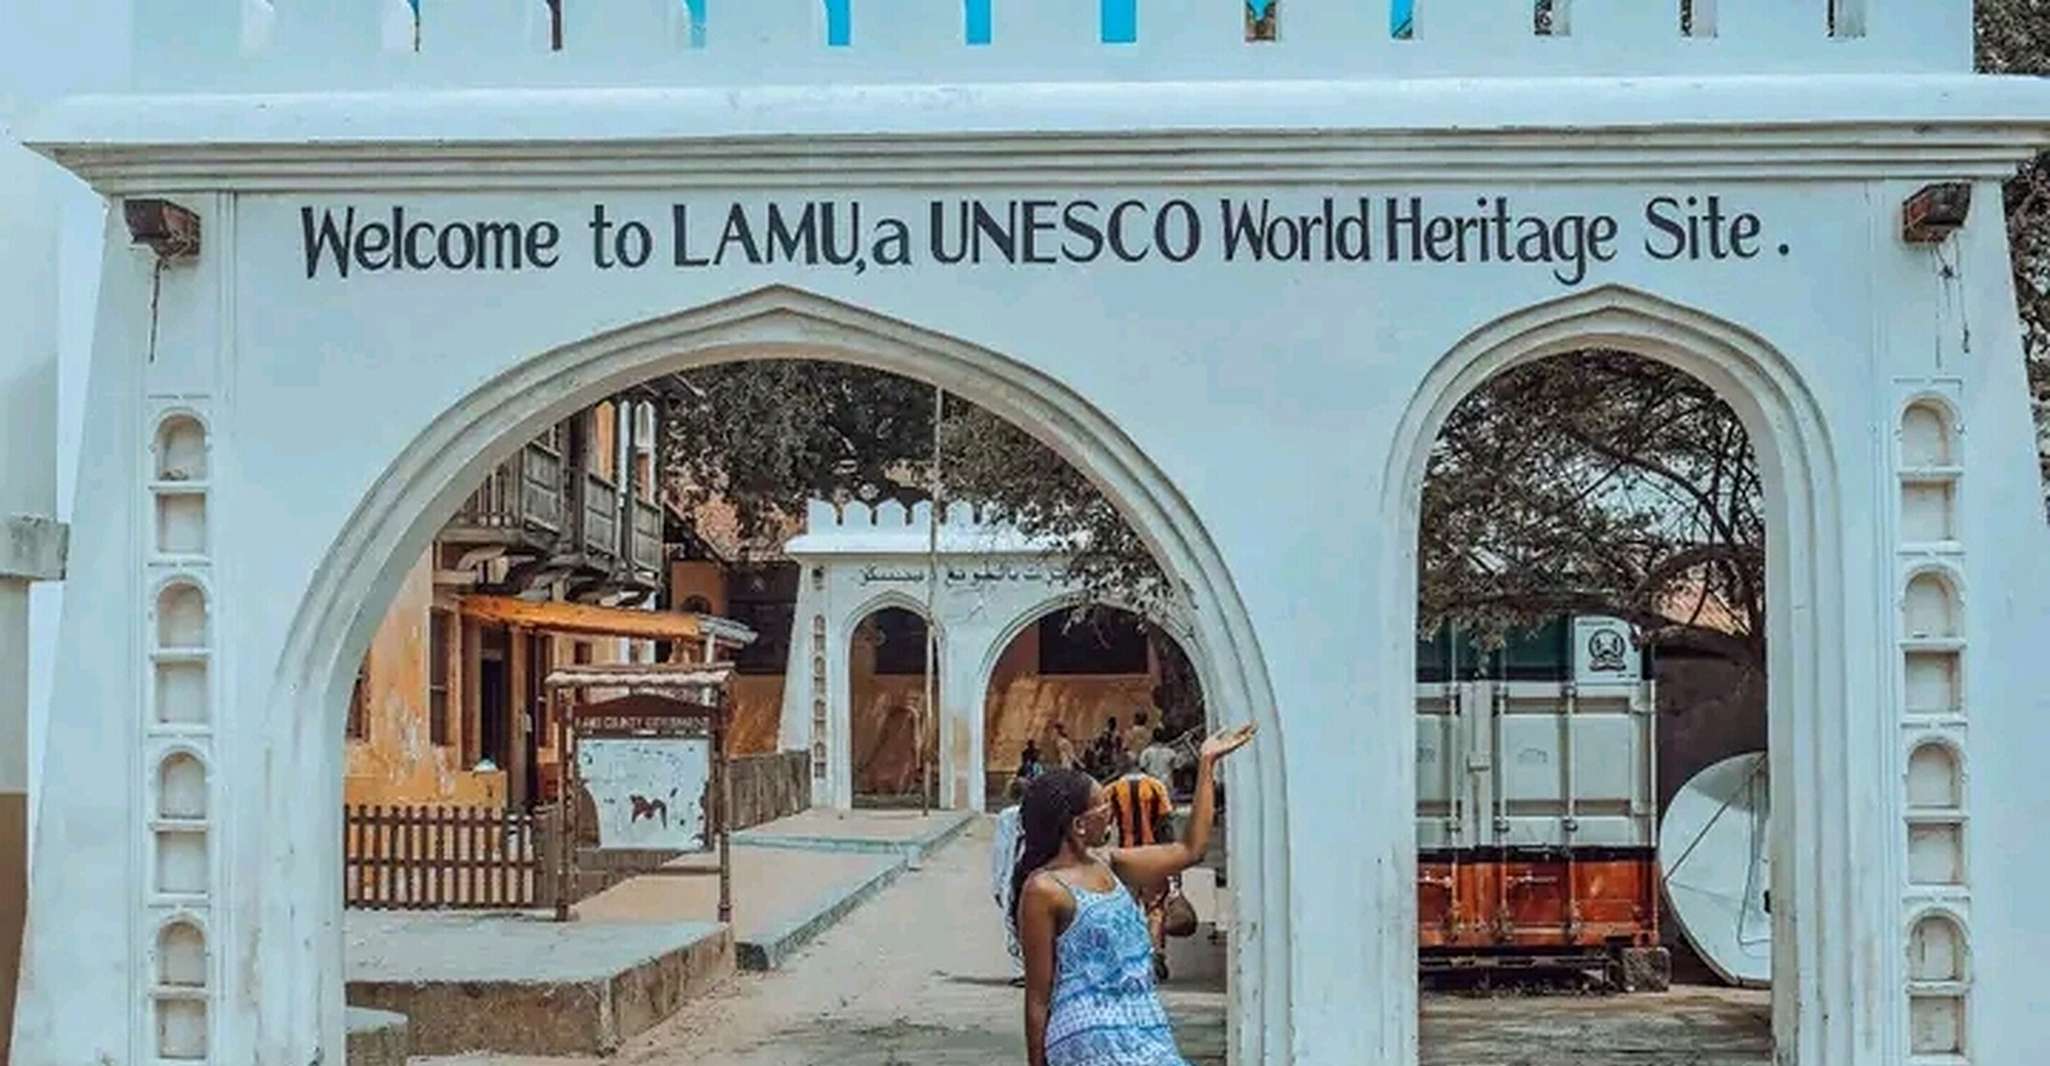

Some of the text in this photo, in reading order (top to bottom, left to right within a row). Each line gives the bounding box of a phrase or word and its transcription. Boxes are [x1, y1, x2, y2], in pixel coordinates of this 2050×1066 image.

[300, 205, 560, 279] Welcome
[588, 204, 653, 270] to
[930, 199, 1201, 265] UNESCO
[1220, 197, 1371, 263] World
[1386, 196, 1618, 284] Heritage
